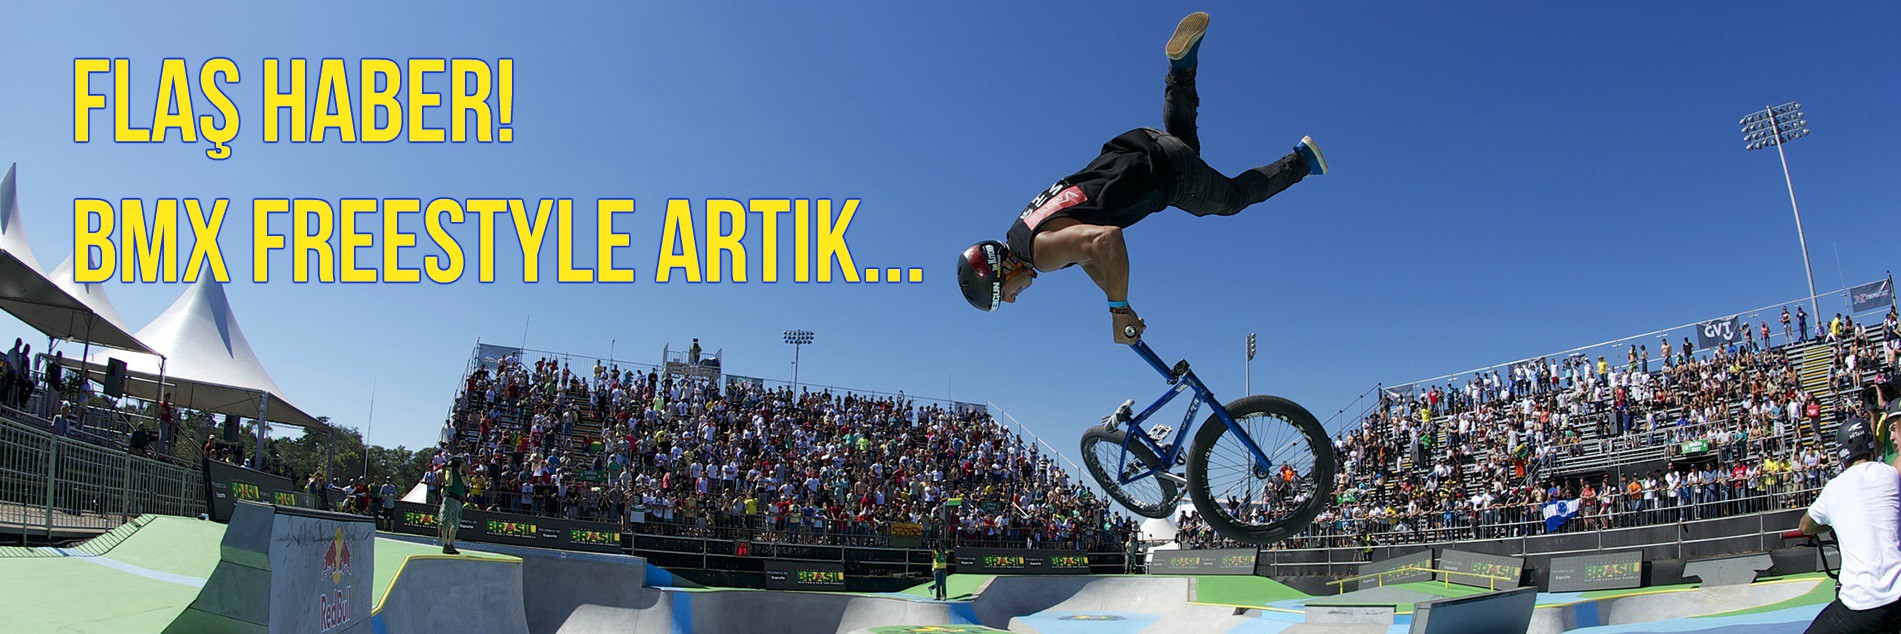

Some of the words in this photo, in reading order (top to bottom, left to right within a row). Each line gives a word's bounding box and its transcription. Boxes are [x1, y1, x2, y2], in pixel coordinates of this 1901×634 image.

[1704, 320, 1733, 339] GVT
[403, 511, 440, 526] BRAS
[486, 519, 537, 535] BRASIL
[569, 528, 621, 544] BRASIL
[983, 555, 1025, 566] BRASIL
[1050, 555, 1089, 567] BRASIL
[796, 570, 845, 583] BRASIL
[1584, 561, 1640, 579] BRASIL
[320, 589, 337, 633] Red
[336, 585, 352, 625] Bull
